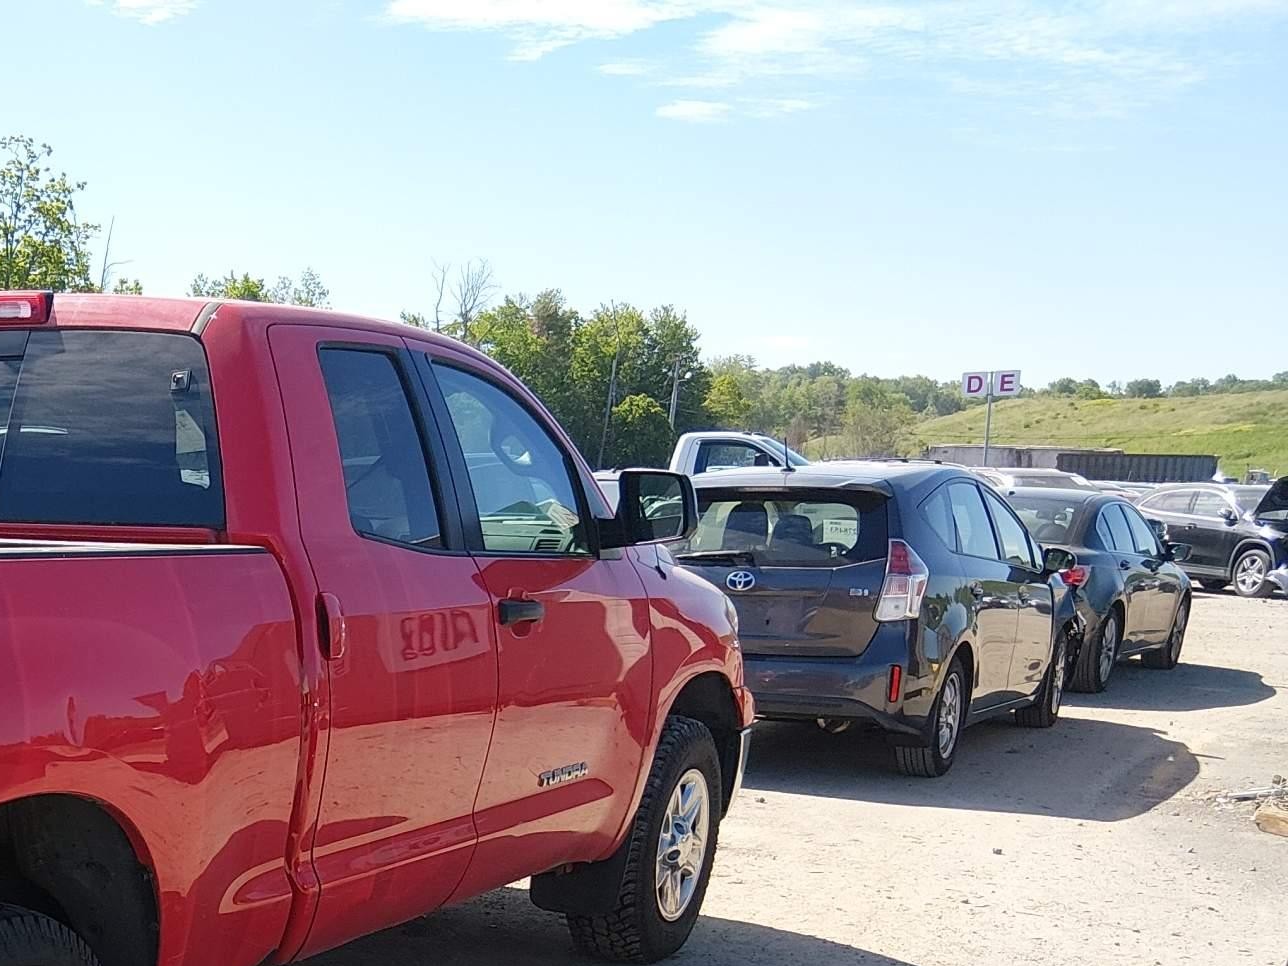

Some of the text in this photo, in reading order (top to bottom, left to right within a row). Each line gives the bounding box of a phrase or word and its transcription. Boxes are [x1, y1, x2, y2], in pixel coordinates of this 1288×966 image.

[966, 375, 984, 394] D
[999, 373, 1016, 393] E
[539, 761, 589, 787] TUNDRA
